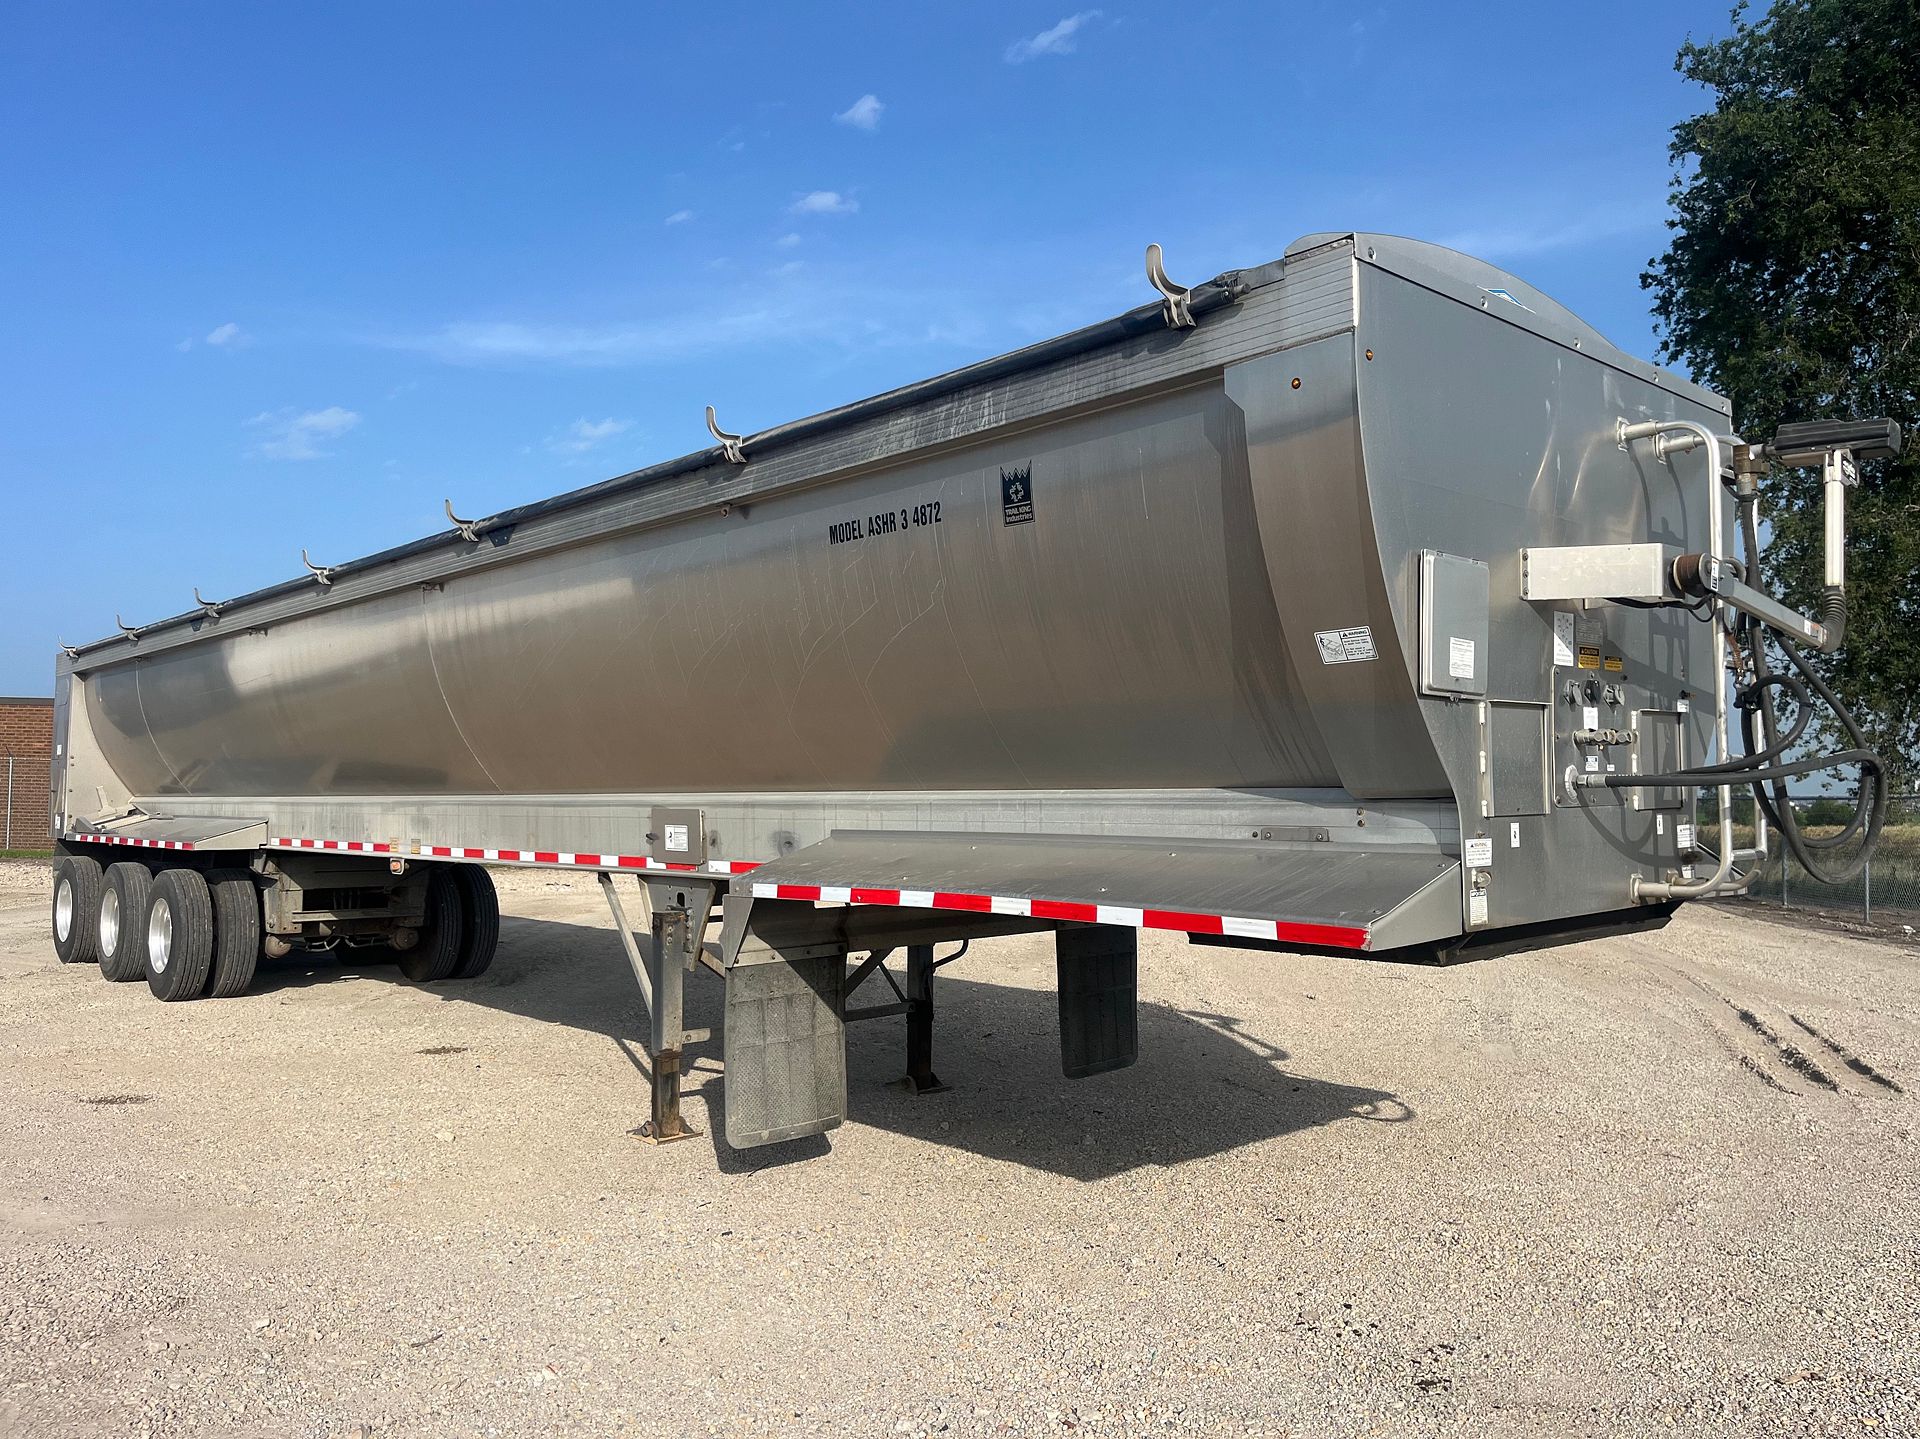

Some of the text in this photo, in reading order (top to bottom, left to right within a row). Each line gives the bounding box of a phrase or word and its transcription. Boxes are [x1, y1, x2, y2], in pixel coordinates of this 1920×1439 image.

[829, 501, 942, 545] MODEL ASHR 3 4872
